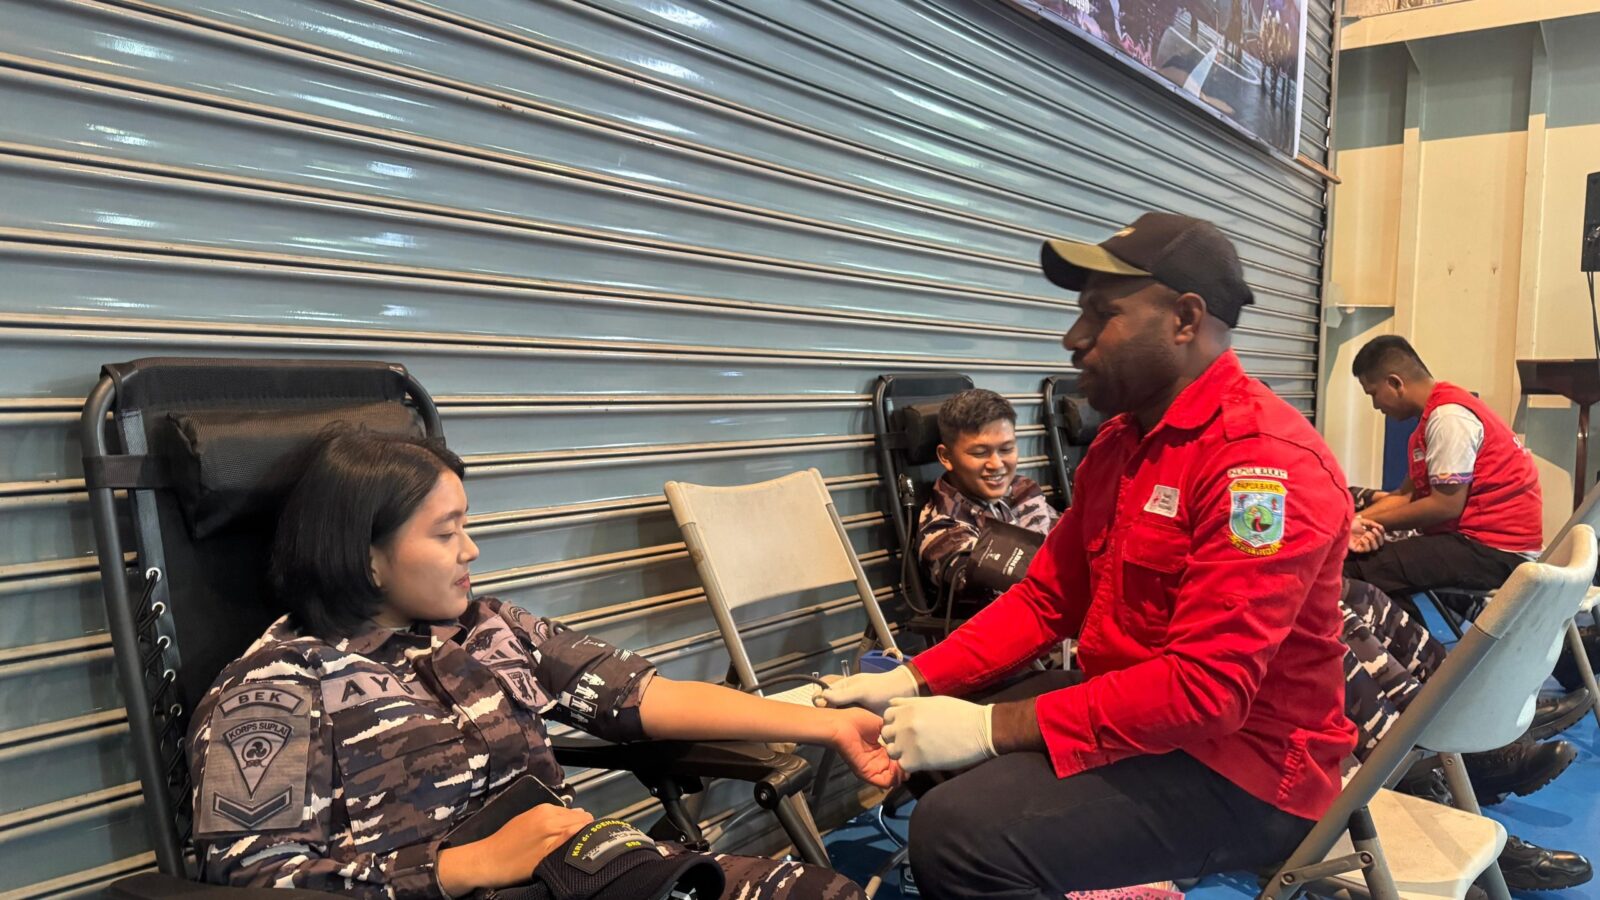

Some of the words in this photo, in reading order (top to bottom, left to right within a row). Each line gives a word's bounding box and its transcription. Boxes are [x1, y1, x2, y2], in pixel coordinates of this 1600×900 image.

[238, 691, 282, 704] BEK
[228, 723, 258, 740] KORPS
[258, 722, 289, 736] SUPLAI
[572, 843, 584, 857] KRI
